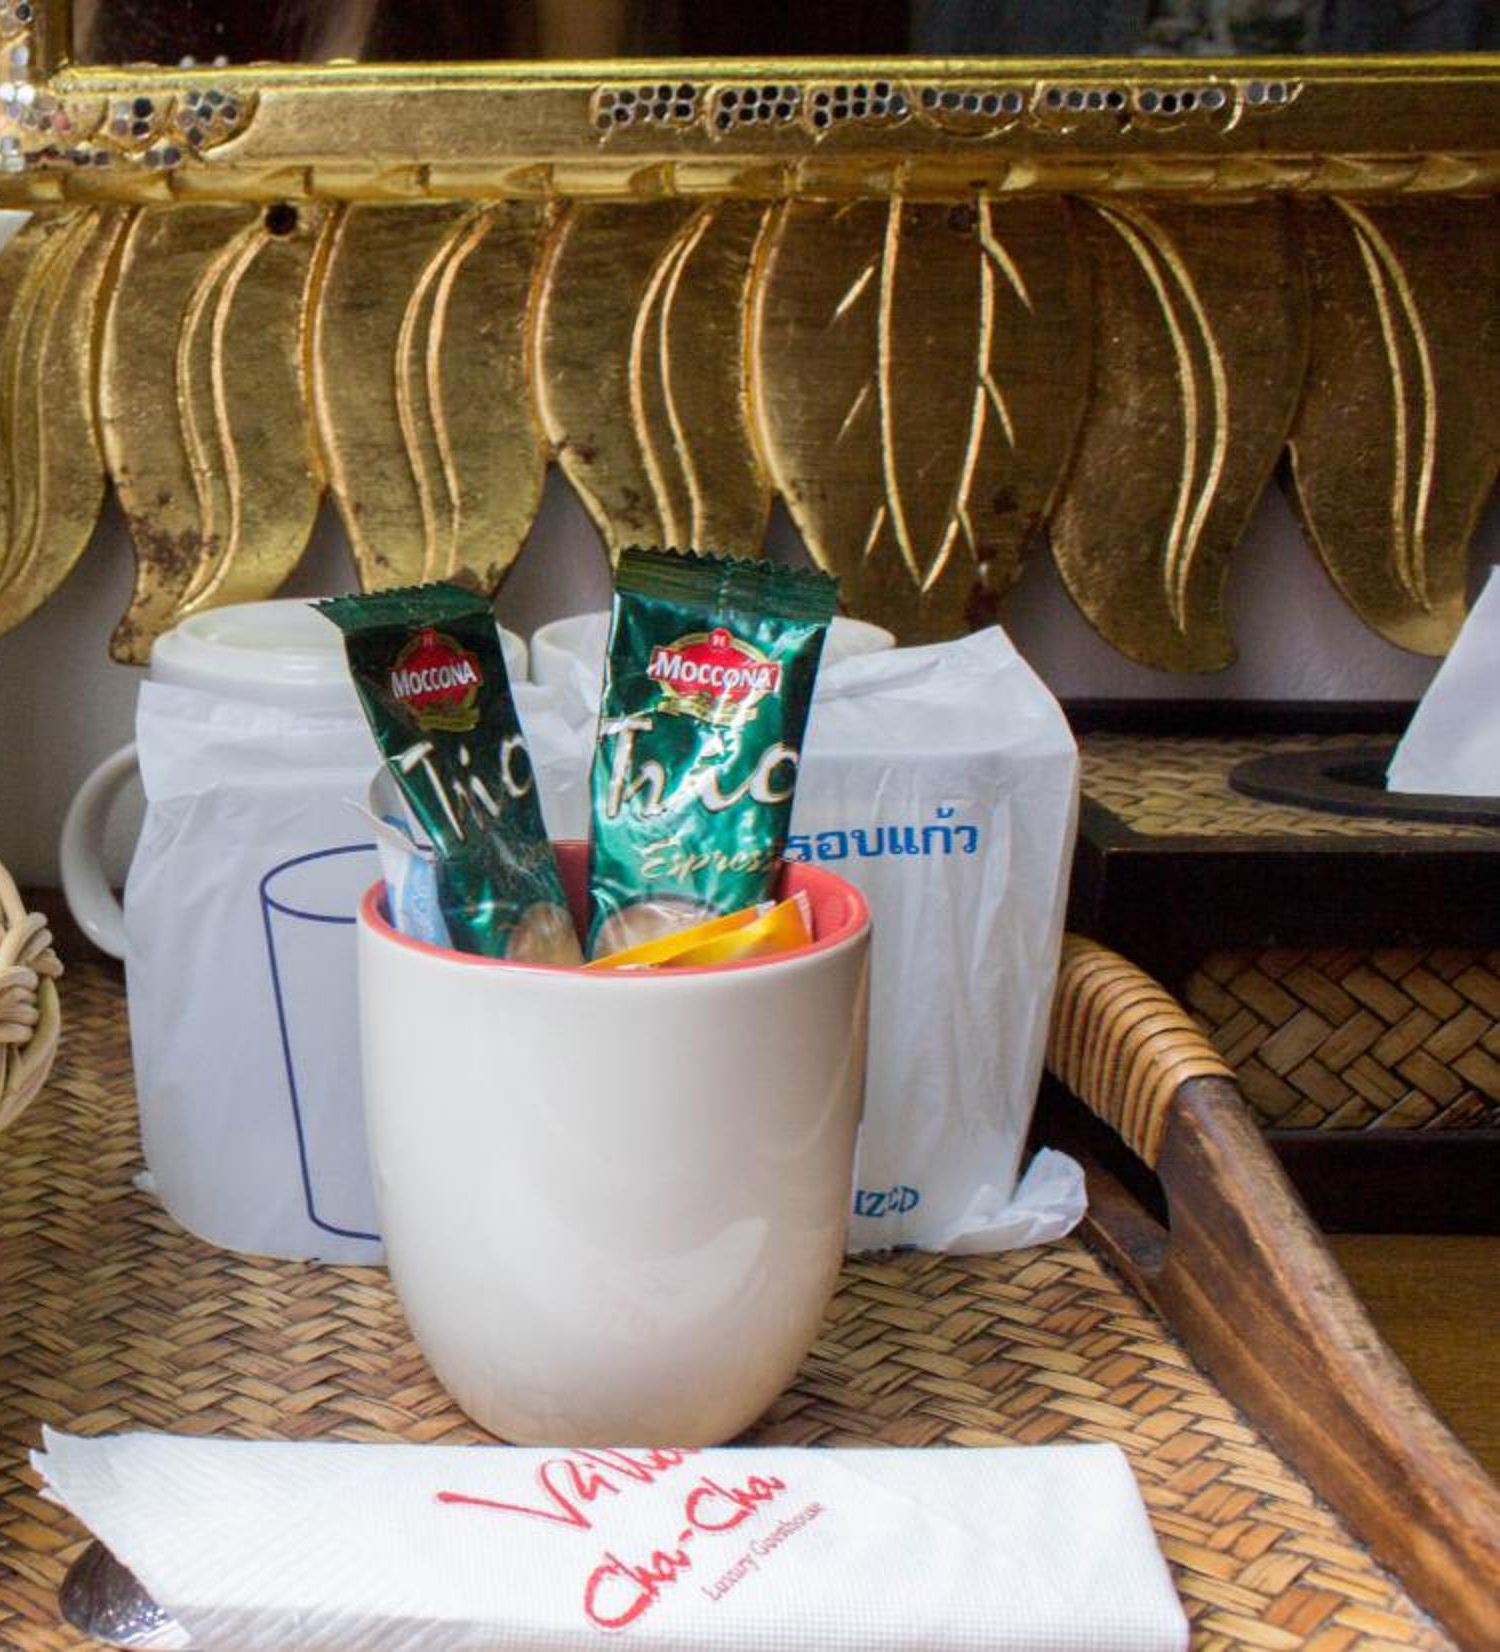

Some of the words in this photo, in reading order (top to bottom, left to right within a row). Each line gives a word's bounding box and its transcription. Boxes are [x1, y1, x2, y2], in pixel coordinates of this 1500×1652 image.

[390, 658, 478, 700] MOCCONA
[654, 650, 773, 689] MOCCONA
[600, 716, 800, 819] Trio
[785, 806, 978, 863] รอบแก้ว
[583, 1473, 786, 1629] Cha-Cha
[700, 1552, 761, 1602] Luxury
